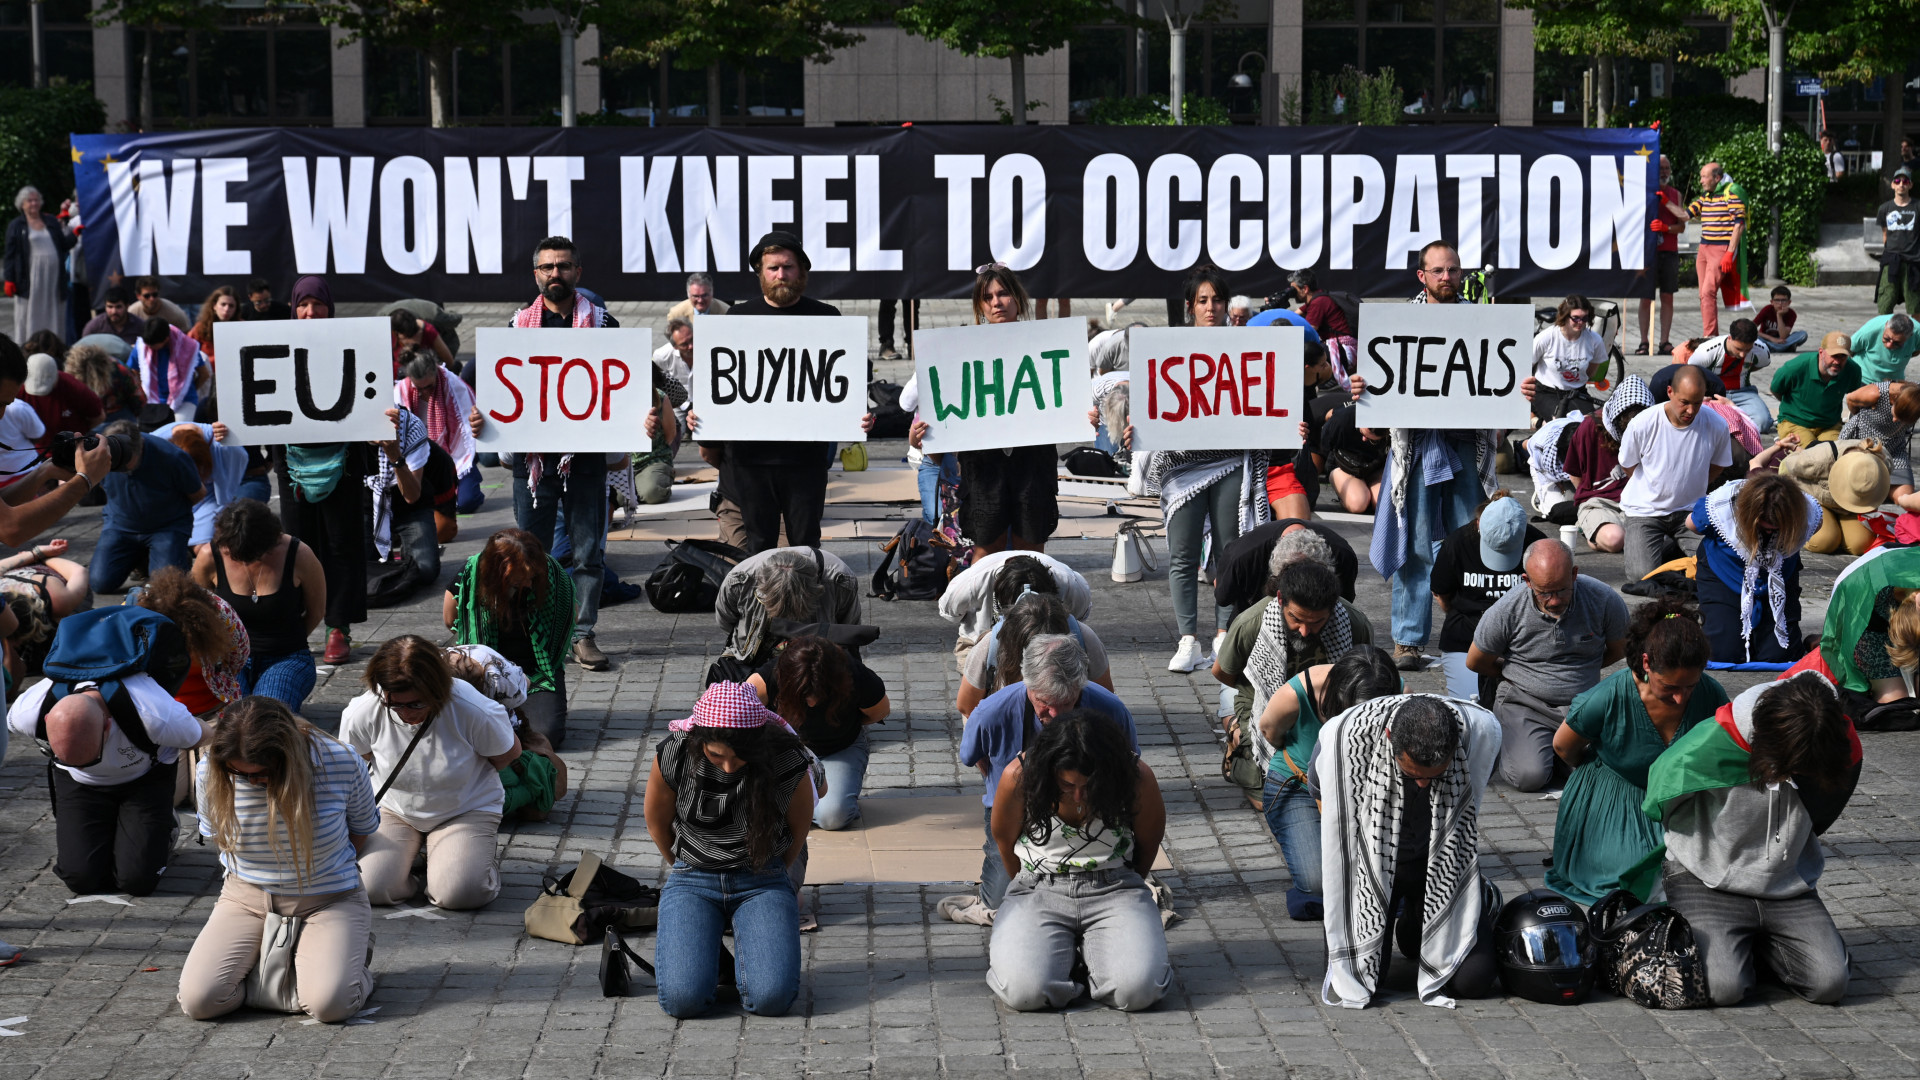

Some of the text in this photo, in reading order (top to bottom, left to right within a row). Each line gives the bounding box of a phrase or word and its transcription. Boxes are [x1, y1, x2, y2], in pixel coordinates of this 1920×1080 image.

[108, 153, 1647, 276] WE WON'T KNEEL TO OCCUPATION
[240, 344, 377, 427] EU:
[489, 355, 631, 423] STOP
[711, 347, 849, 406] BUYING
[929, 349, 1070, 422] WHAT
[1148, 351, 1289, 423] ISRAEL
[1367, 335, 1517, 397] STEALS
[1463, 572, 1495, 588] DON'T
[1541, 906, 1568, 916] SHOEI
